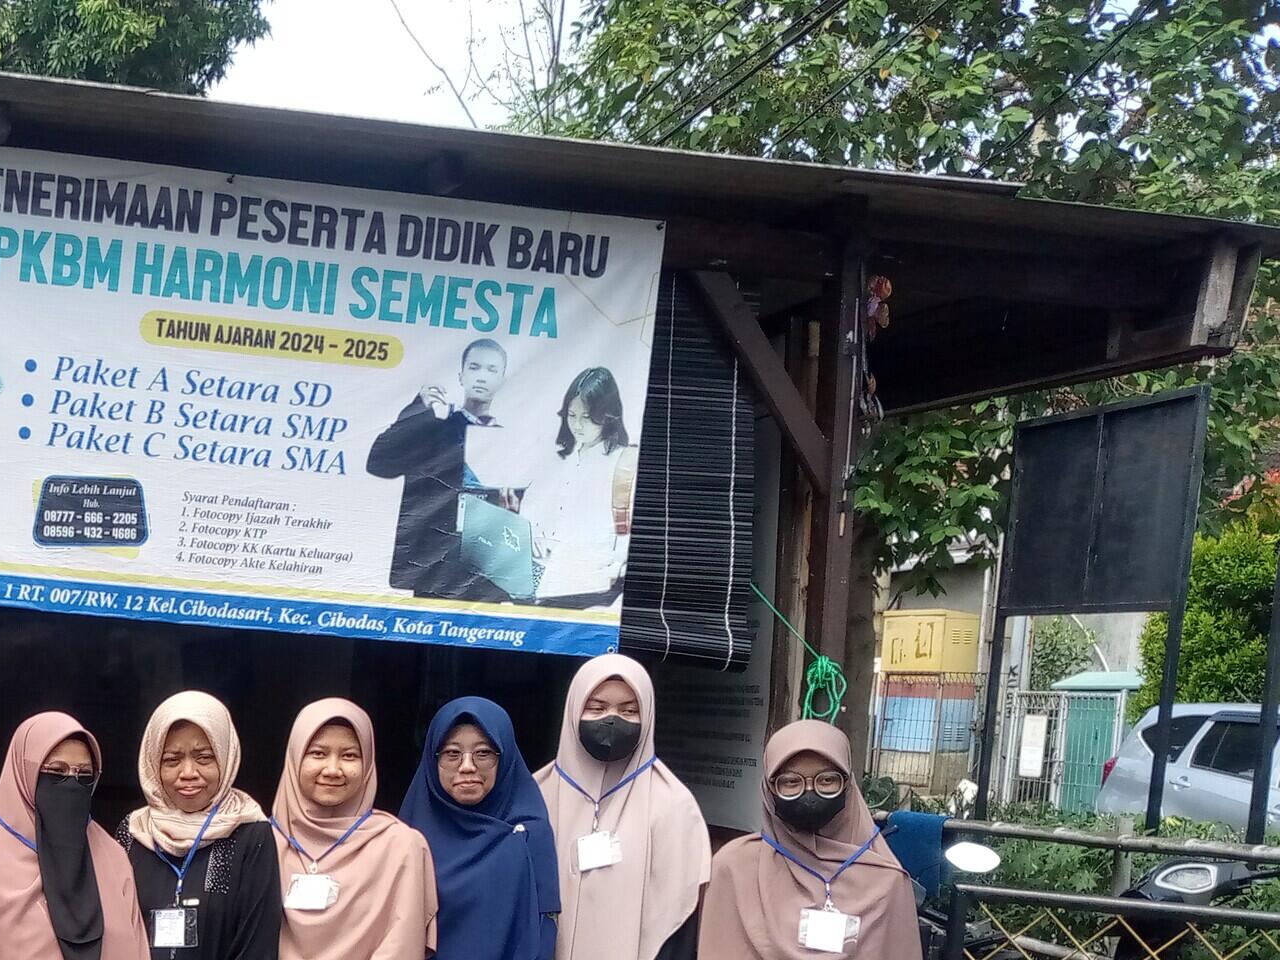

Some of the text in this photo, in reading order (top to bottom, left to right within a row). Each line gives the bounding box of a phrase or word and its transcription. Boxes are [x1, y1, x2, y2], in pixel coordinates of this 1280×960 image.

[210, 192, 386, 255] PESERTA
[396, 214, 501, 267] DIDIK
[506, 226, 610, 279] BARU
[132, 241, 339, 315] HARMONI
[349, 266, 558, 339] SEMESTA
[155, 317, 211, 343] TAHUN
[214, 324, 276, 350] AJARAN
[279, 331, 325, 354] 2024
[343, 338, 389, 361] 2025
[51, 356, 332, 408] Paket A Setara SD
[48, 389, 348, 443] Paket B Setara SMP
[46, 421, 347, 475] Paket C Setara SMA
[48, 483, 137, 498] Info Lebih Lanjut
[182, 490, 219, 505] Syarat
[221, 494, 290, 511] Pendaftaran
[82, 499, 100, 508] Hub.
[43, 510, 75, 523] 08777
[84, 511, 103, 523] 666
[112, 512, 138, 525] 2205
[178, 521, 268, 539] 2. Fotocopy KTP
[180, 506, 333, 530] 1. Fotocopy Ijazah Terakhir
[43, 525, 75, 538] 08596
[83, 527, 103, 539] 432
[112, 528, 137, 540] 4686
[177, 536, 354, 563] 3. Fotocopy KK (Kartu Keluarga)
[175, 551, 323, 574] 4. Fotocopy Akte Kelahiran
[3, 583, 13, 599] 1
[18, 584, 45, 602] RT.
[50, 587, 119, 610] 007/RW.
[123, 594, 143, 612] 12
[278, 607, 313, 626] Kec.
[317, 610, 388, 634] Cibodas,
[393, 617, 434, 637] Kota
[438, 620, 526, 645] Tangerang
